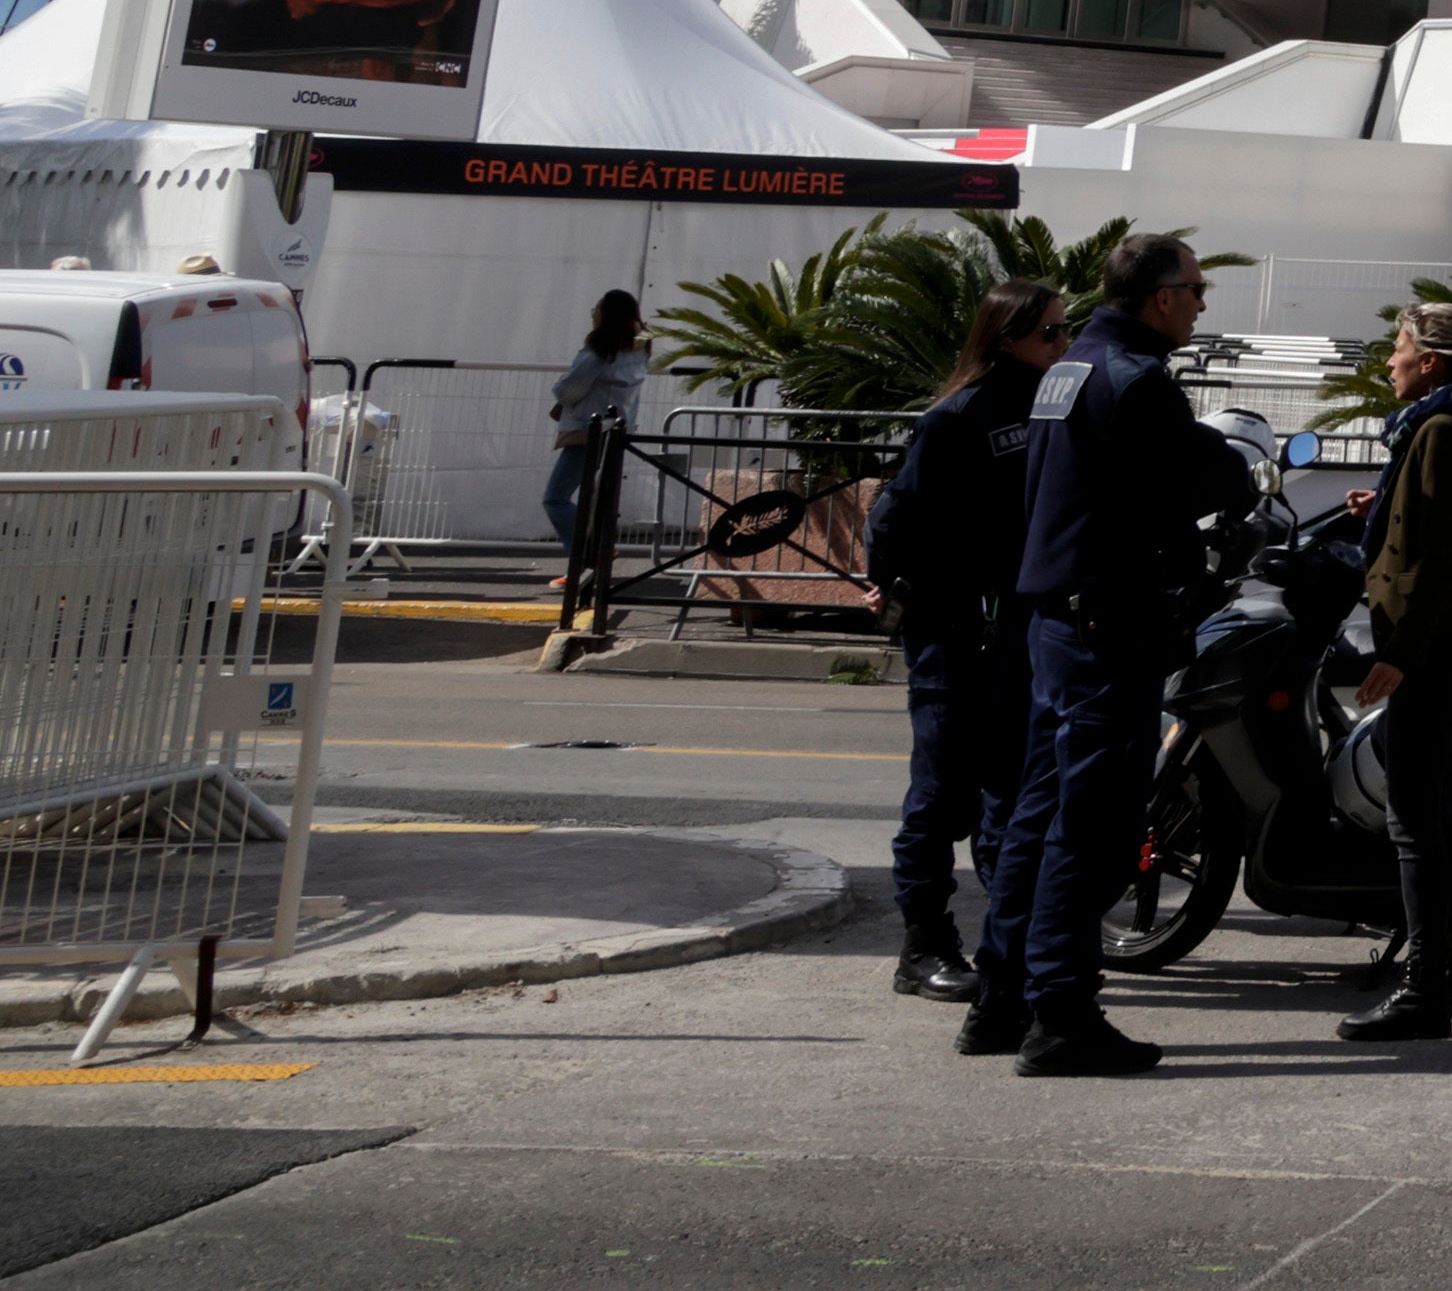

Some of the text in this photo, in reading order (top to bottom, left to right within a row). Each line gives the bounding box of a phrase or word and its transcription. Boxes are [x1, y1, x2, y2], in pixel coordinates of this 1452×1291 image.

[292, 90, 357, 108] JCDecaux
[464, 158, 845, 196] GRAND THÉÂTRE LUMIÈRE
